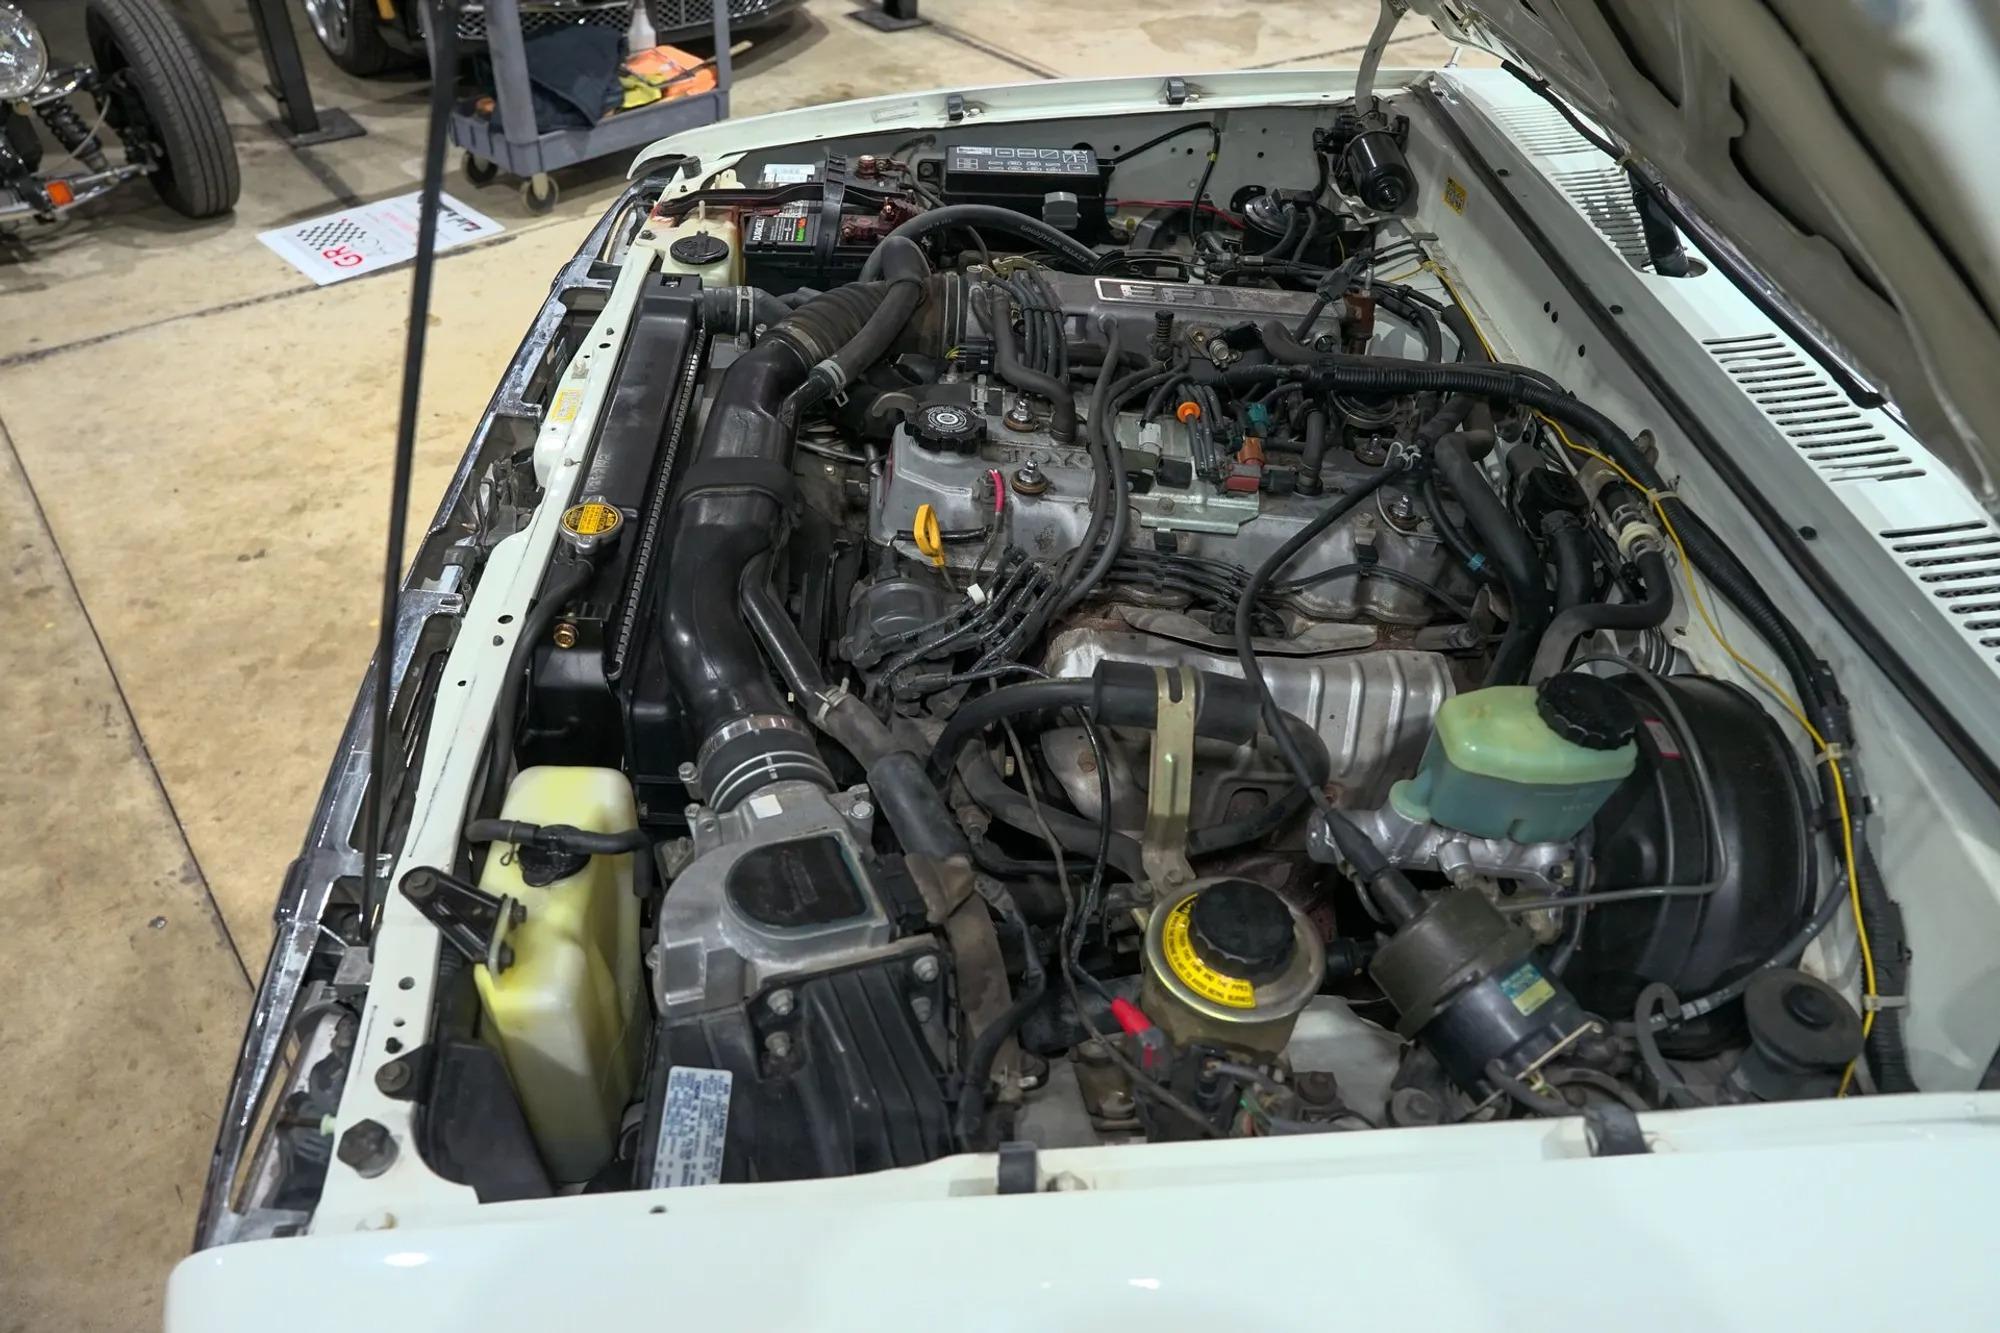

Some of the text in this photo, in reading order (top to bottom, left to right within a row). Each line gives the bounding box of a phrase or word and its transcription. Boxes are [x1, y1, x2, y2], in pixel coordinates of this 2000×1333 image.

[752, 218, 766, 241] DURACELL
[1020, 224, 1061, 248] GOODYEAR
[322, 245, 364, 268] GR
[1119, 283, 1216, 306] EFI
